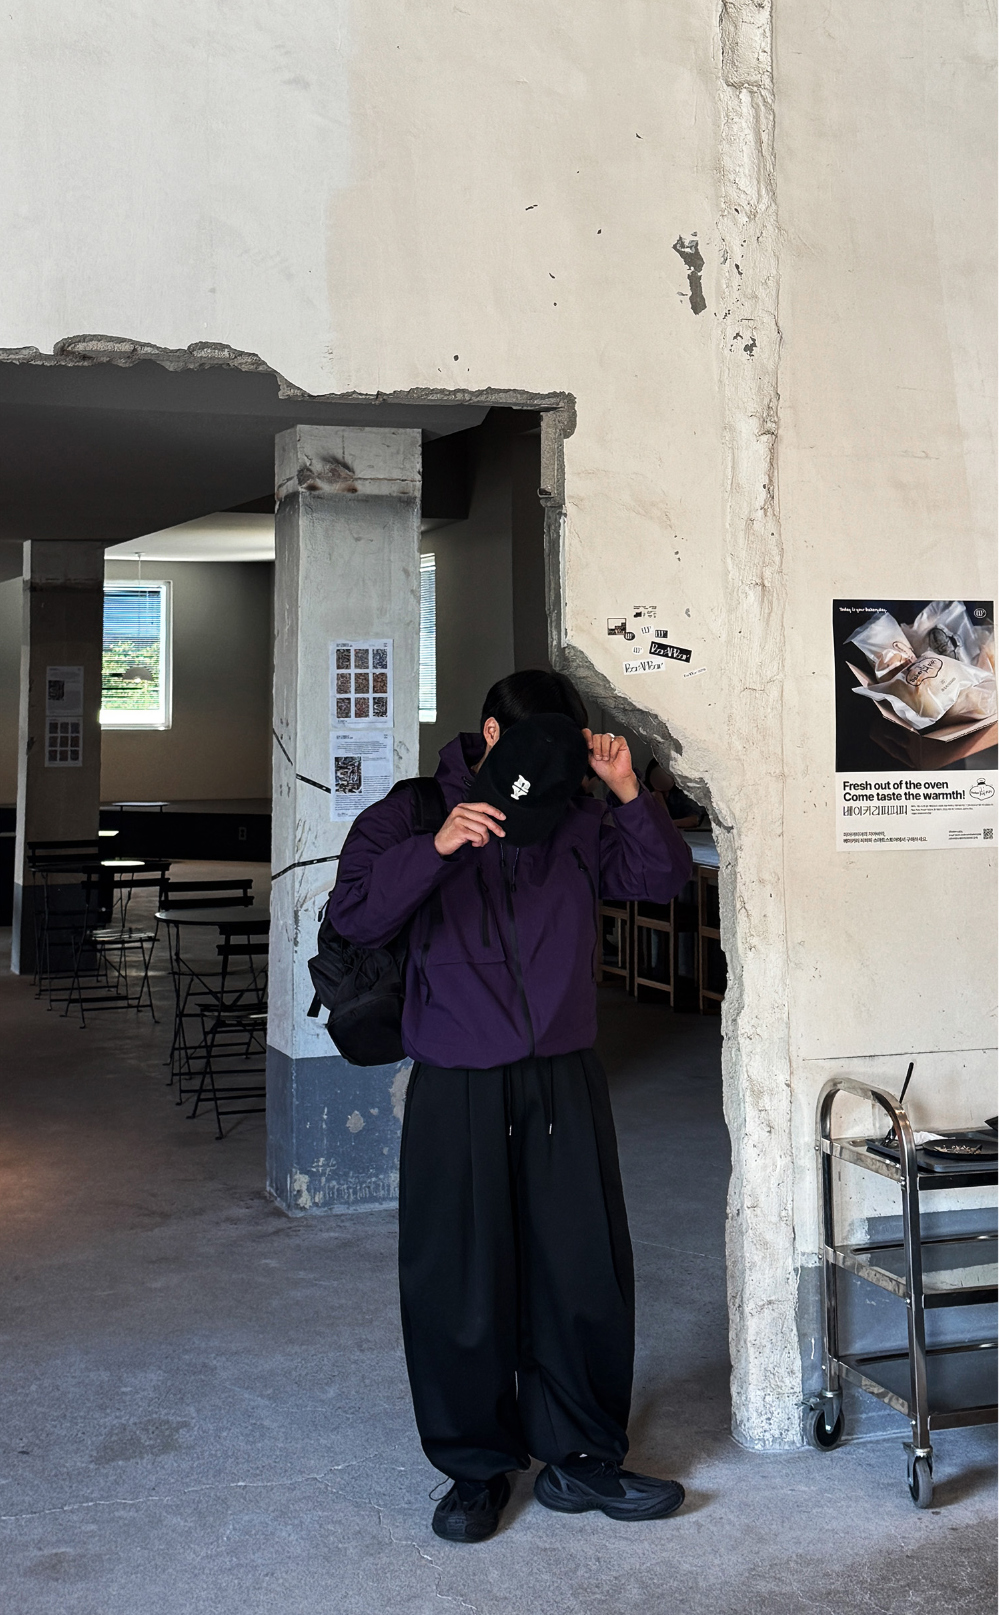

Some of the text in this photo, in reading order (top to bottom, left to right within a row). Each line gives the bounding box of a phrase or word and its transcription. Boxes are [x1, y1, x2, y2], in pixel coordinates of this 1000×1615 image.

[843, 780, 949, 791] Fresh out of the oven
[843, 792, 874, 802] Come
[876, 792, 902, 801] taste
[904, 791, 921, 800] the
[923, 790, 965, 801] warmth!
